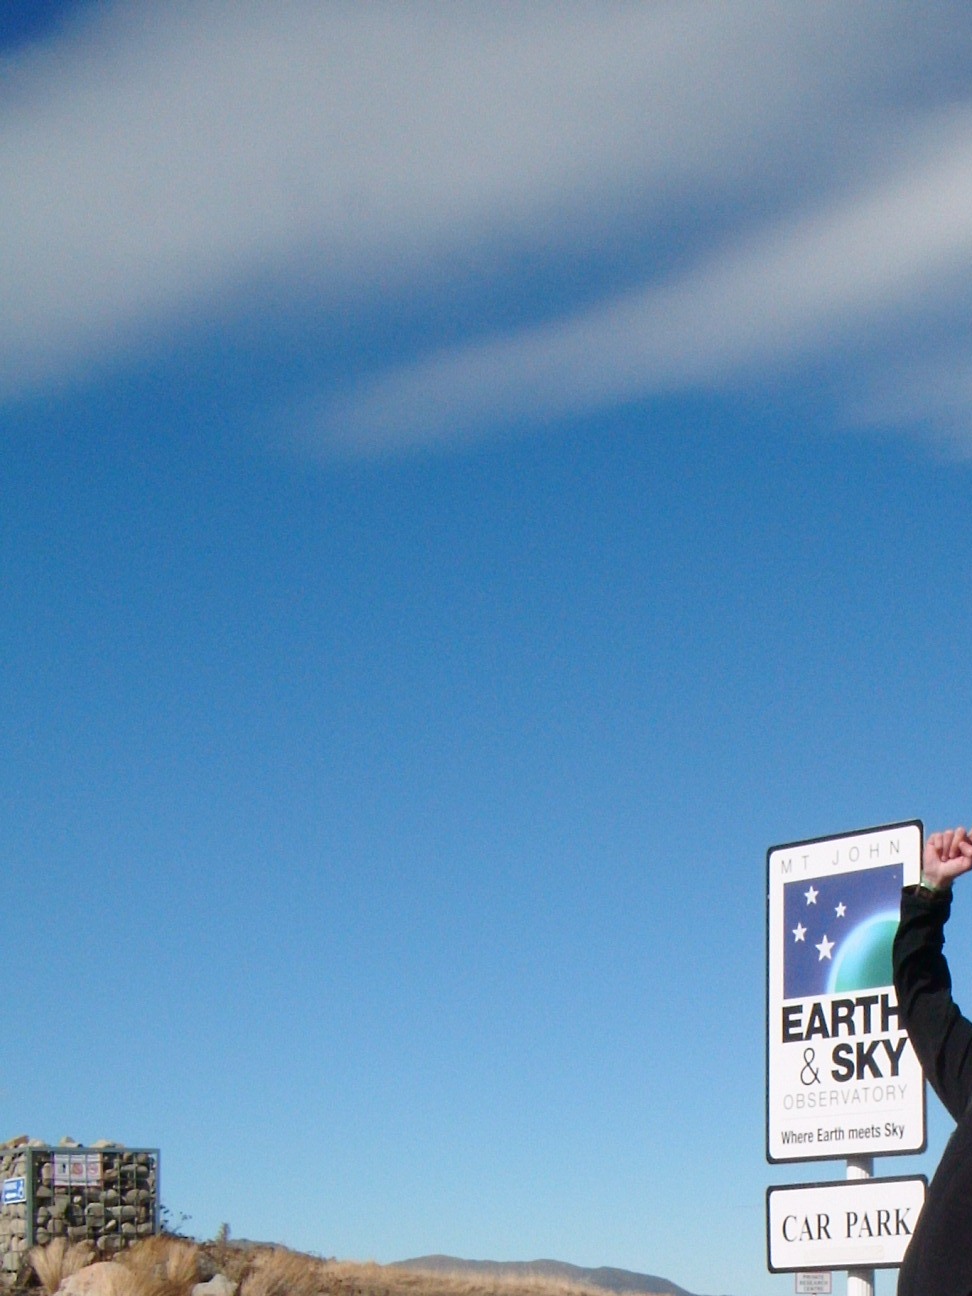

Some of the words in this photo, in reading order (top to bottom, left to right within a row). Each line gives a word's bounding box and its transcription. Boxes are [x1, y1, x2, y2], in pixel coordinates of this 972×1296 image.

[780, 855, 810, 875] MT
[832, 840, 901, 866] JOHN
[782, 994, 905, 1043] EARTH
[800, 1047, 821, 1086] &
[831, 1036, 908, 1083] SKY
[783, 1084, 908, 1110] OBSERVATORY
[781, 1128, 814, 1145] Where
[817, 1125, 845, 1143] Earth
[848, 1124, 881, 1140] meets
[884, 1122, 905, 1138] Sky
[782, 1213, 832, 1243] CAR
[846, 1207, 913, 1239] PARK
